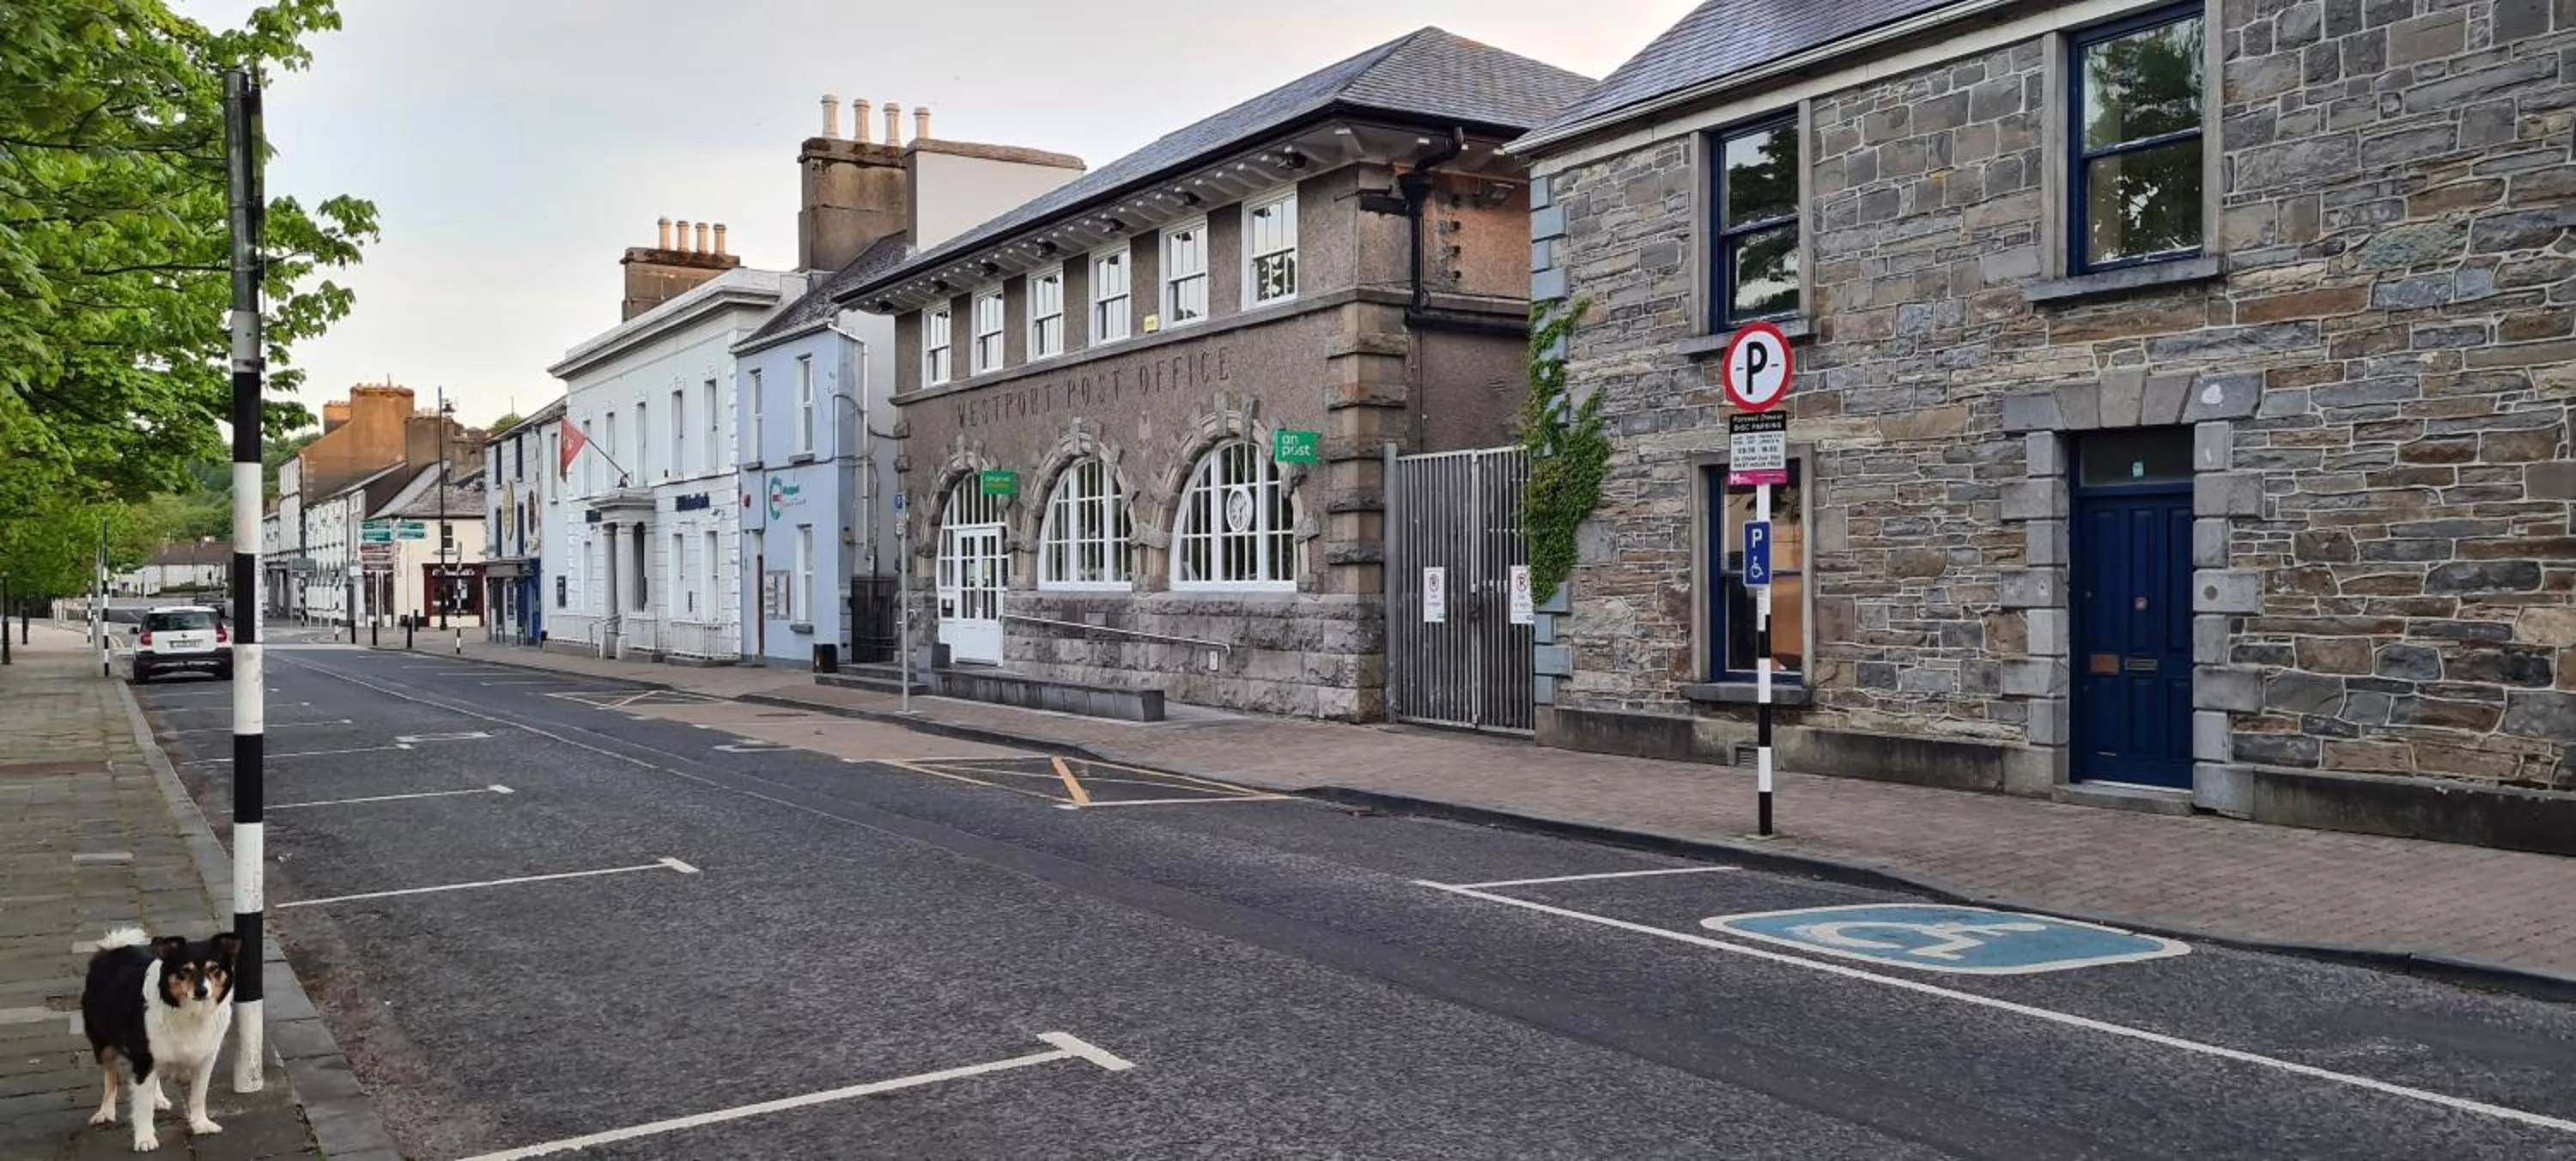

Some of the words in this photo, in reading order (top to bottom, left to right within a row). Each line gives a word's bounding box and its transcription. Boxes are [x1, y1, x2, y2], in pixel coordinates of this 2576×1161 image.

[957, 383, 1052, 429] WESTPORT
[1067, 369, 1122, 409] POST
[1139, 347, 1229, 398] OFFICE
[1282, 445, 1310, 459] post
[1752, 528, 1763, 548] P
